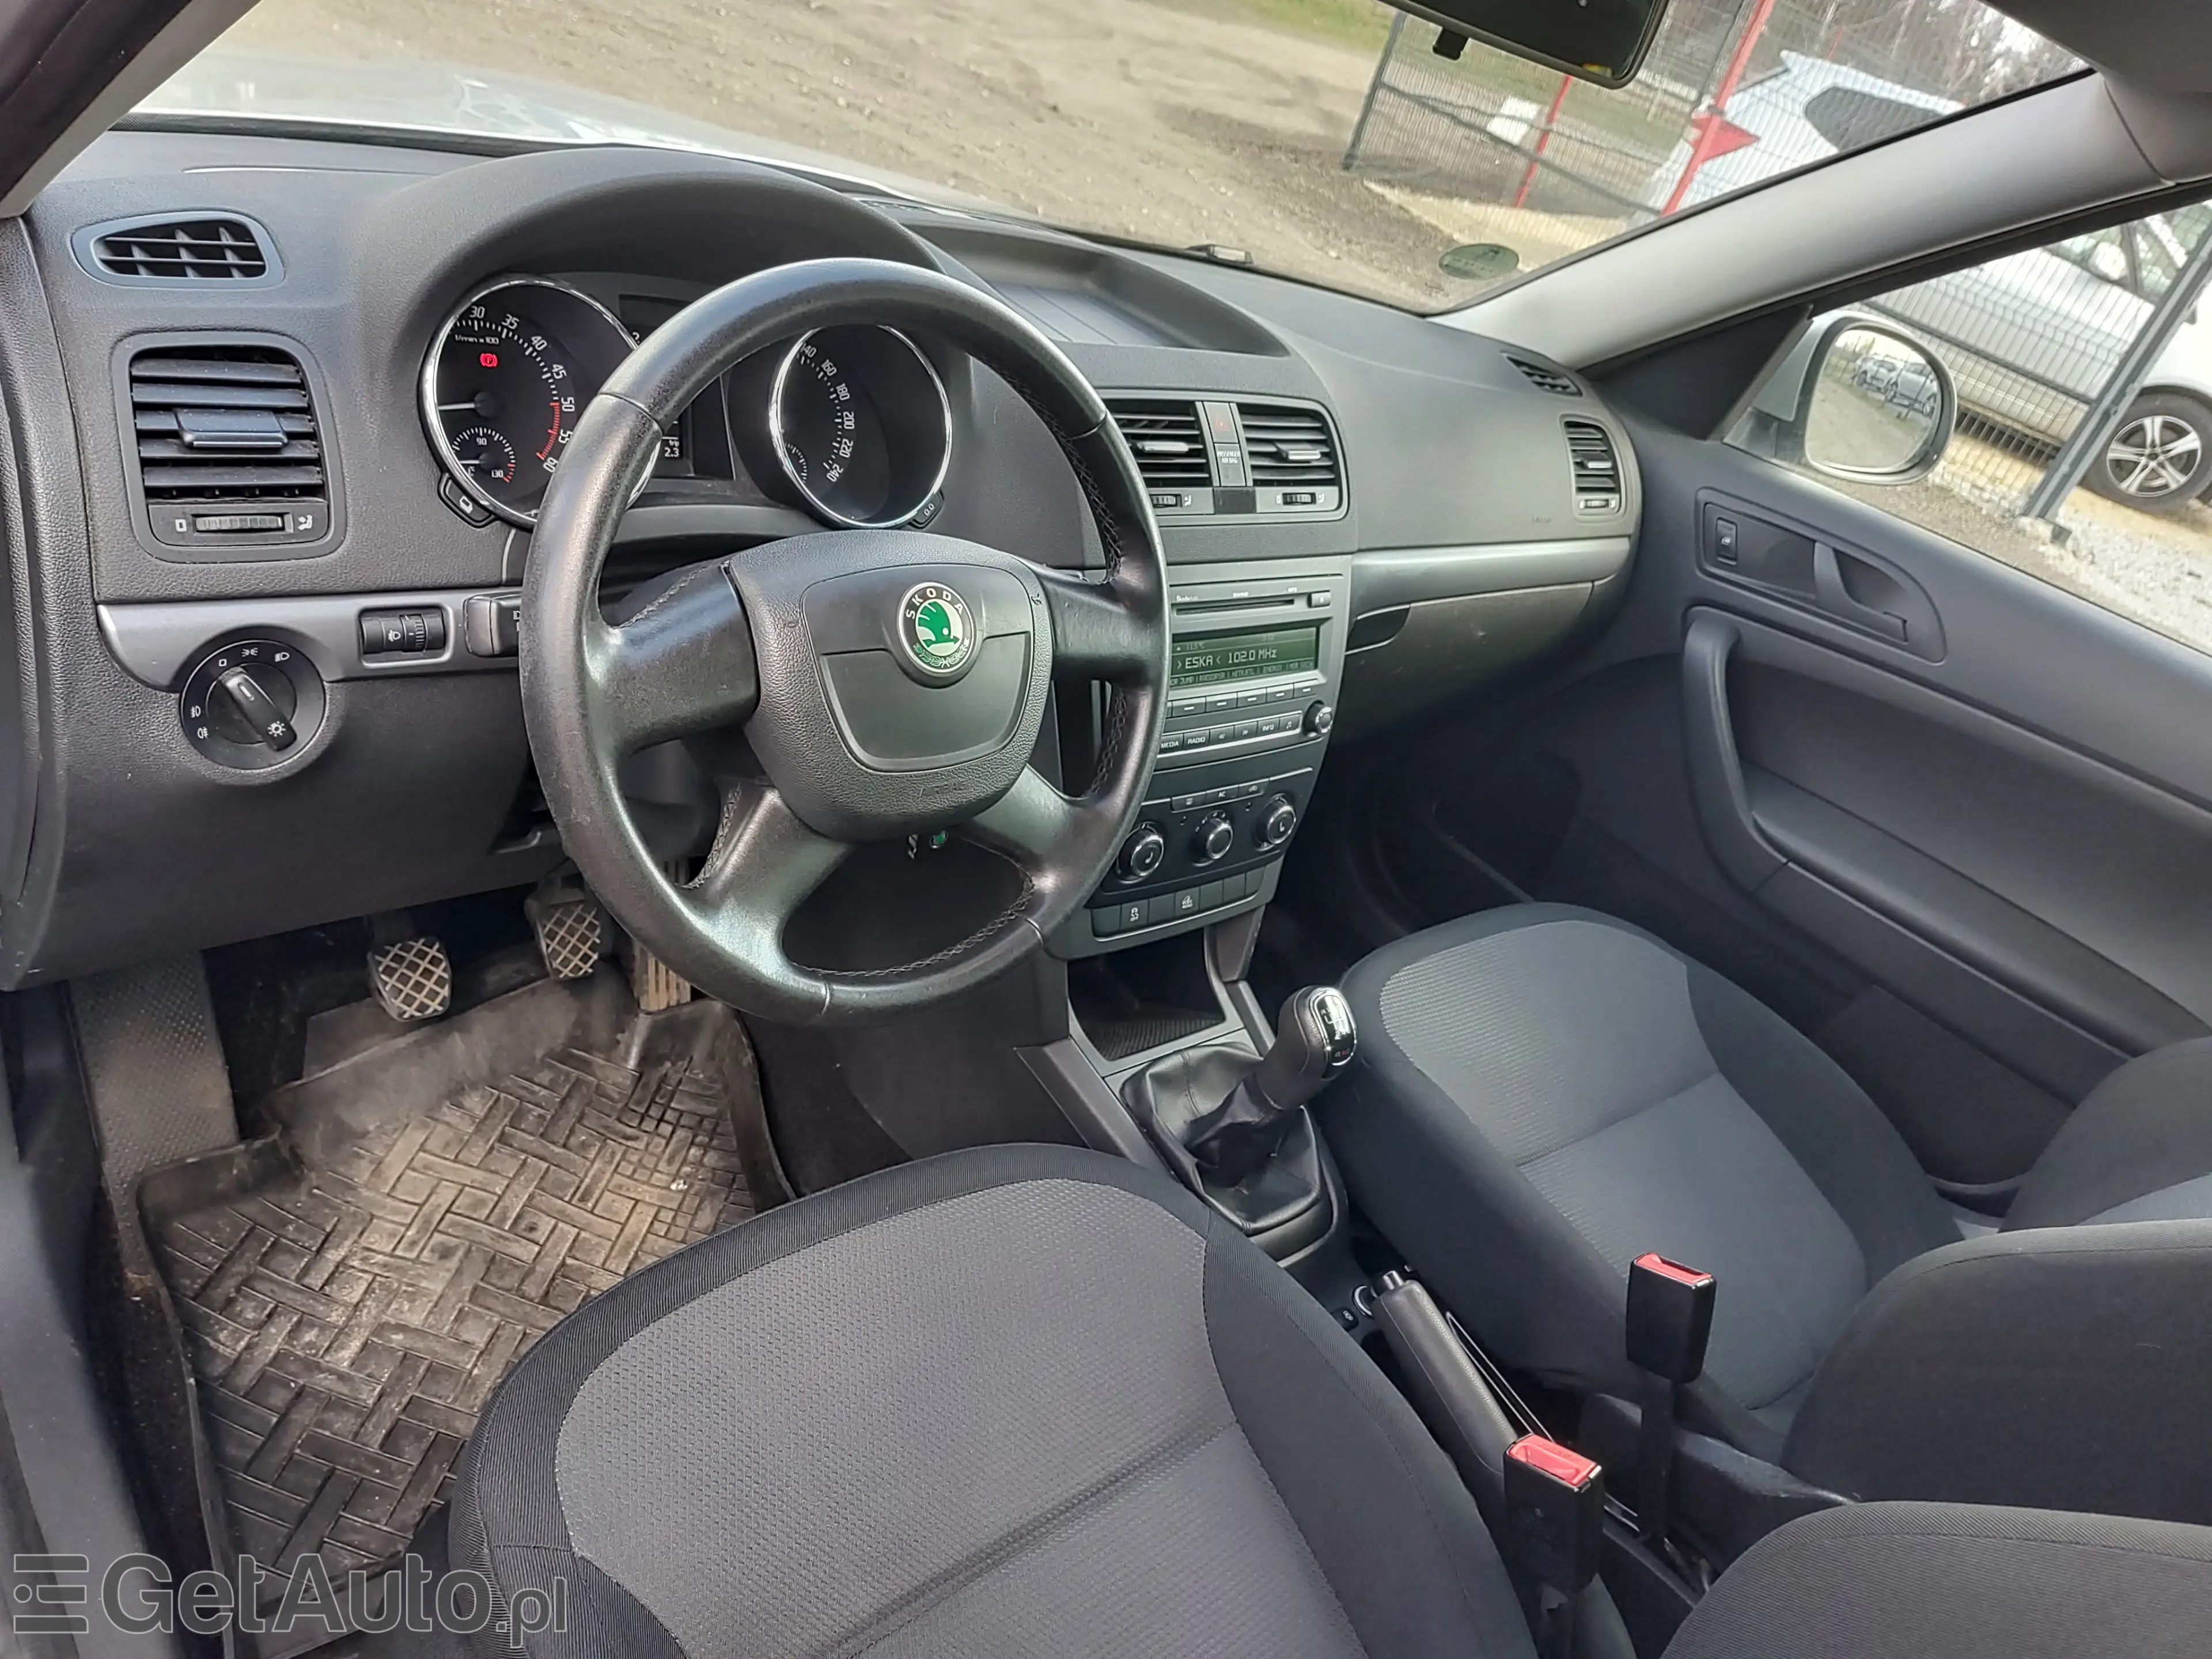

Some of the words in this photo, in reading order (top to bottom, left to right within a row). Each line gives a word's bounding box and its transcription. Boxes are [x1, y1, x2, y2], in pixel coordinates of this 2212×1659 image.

[469, 306, 485, 319] 30
[501, 313, 520, 329] 35
[531, 335, 547, 351] 40
[552, 363, 567, 380] 45
[821, 359, 837, 376] 160
[836, 383, 850, 400] 180
[561, 397, 575, 412] 50
[843, 411, 854, 429] 200
[476, 437, 487, 445] 90
[558, 429, 573, 444] 55
[839, 439, 853, 458] 220
[543, 457, 559, 473] 60
[827, 464, 843, 482] 240
[491, 469, 503, 478] 130
[1185, 655, 1213, 669] ESKA
[1228, 650, 1255, 663] 102.0
[1258, 647, 1277, 660] MHz
[1161, 740, 1179, 749] MEDIA
[1187, 736, 1206, 745] RADIO
